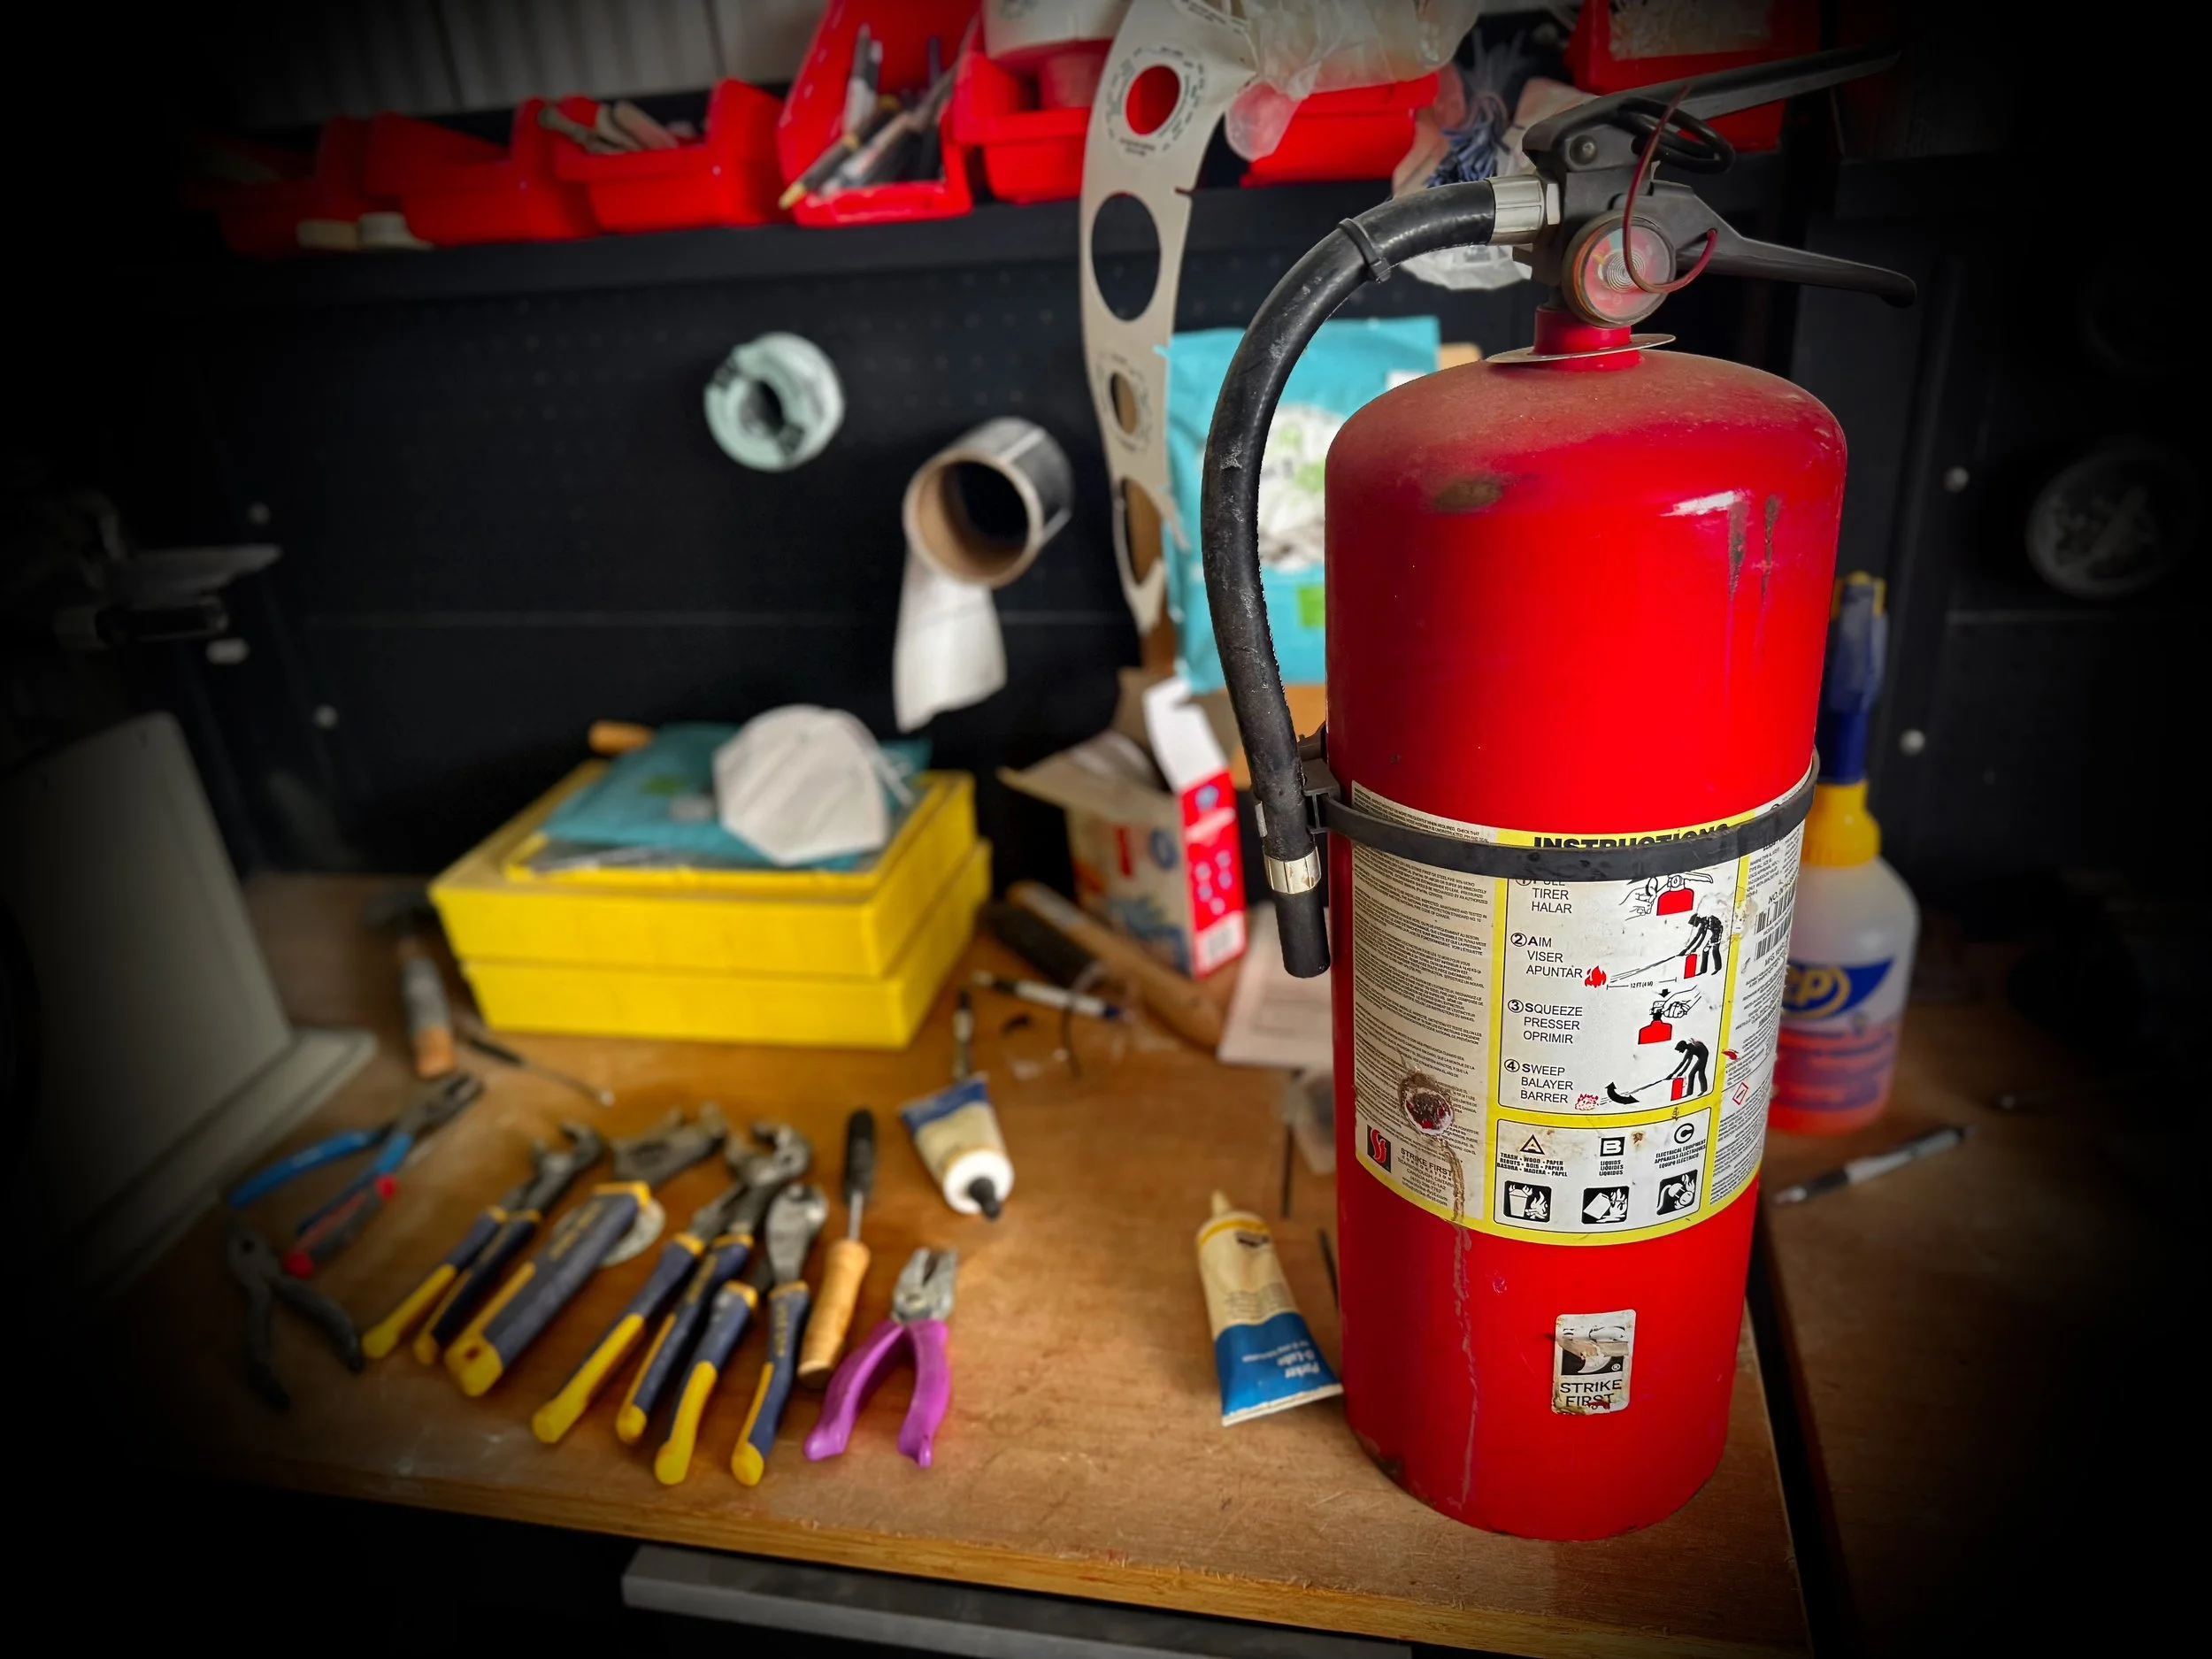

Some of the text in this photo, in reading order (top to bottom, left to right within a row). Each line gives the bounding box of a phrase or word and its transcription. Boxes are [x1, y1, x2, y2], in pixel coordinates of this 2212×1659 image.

[1532, 887, 1569, 900] TIRER
[1532, 901, 1572, 914] HALAR
[1528, 936, 1552, 948] AIM
[1527, 950, 1563, 964] VISER
[1526, 965, 1583, 979] APUNTAR
[1525, 1002, 1583, 1017] SQUEEZE
[1524, 1017, 1580, 1031] PRESSER
[1523, 1030, 1573, 1044] OPRIMIR
[1522, 1063, 1565, 1076] SWEEP
[1521, 1076, 1573, 1090] BALAYER
[1520, 1089, 1568, 1103] BARRER
[1655, 1139, 1706, 1158] ELECTRICAL EQUIPMENT
[1401, 1147, 1452, 1177] STRIKE FIRST
[1560, 1379, 1622, 1394] STRIKE
[1566, 1394, 1614, 1407] FIRST
